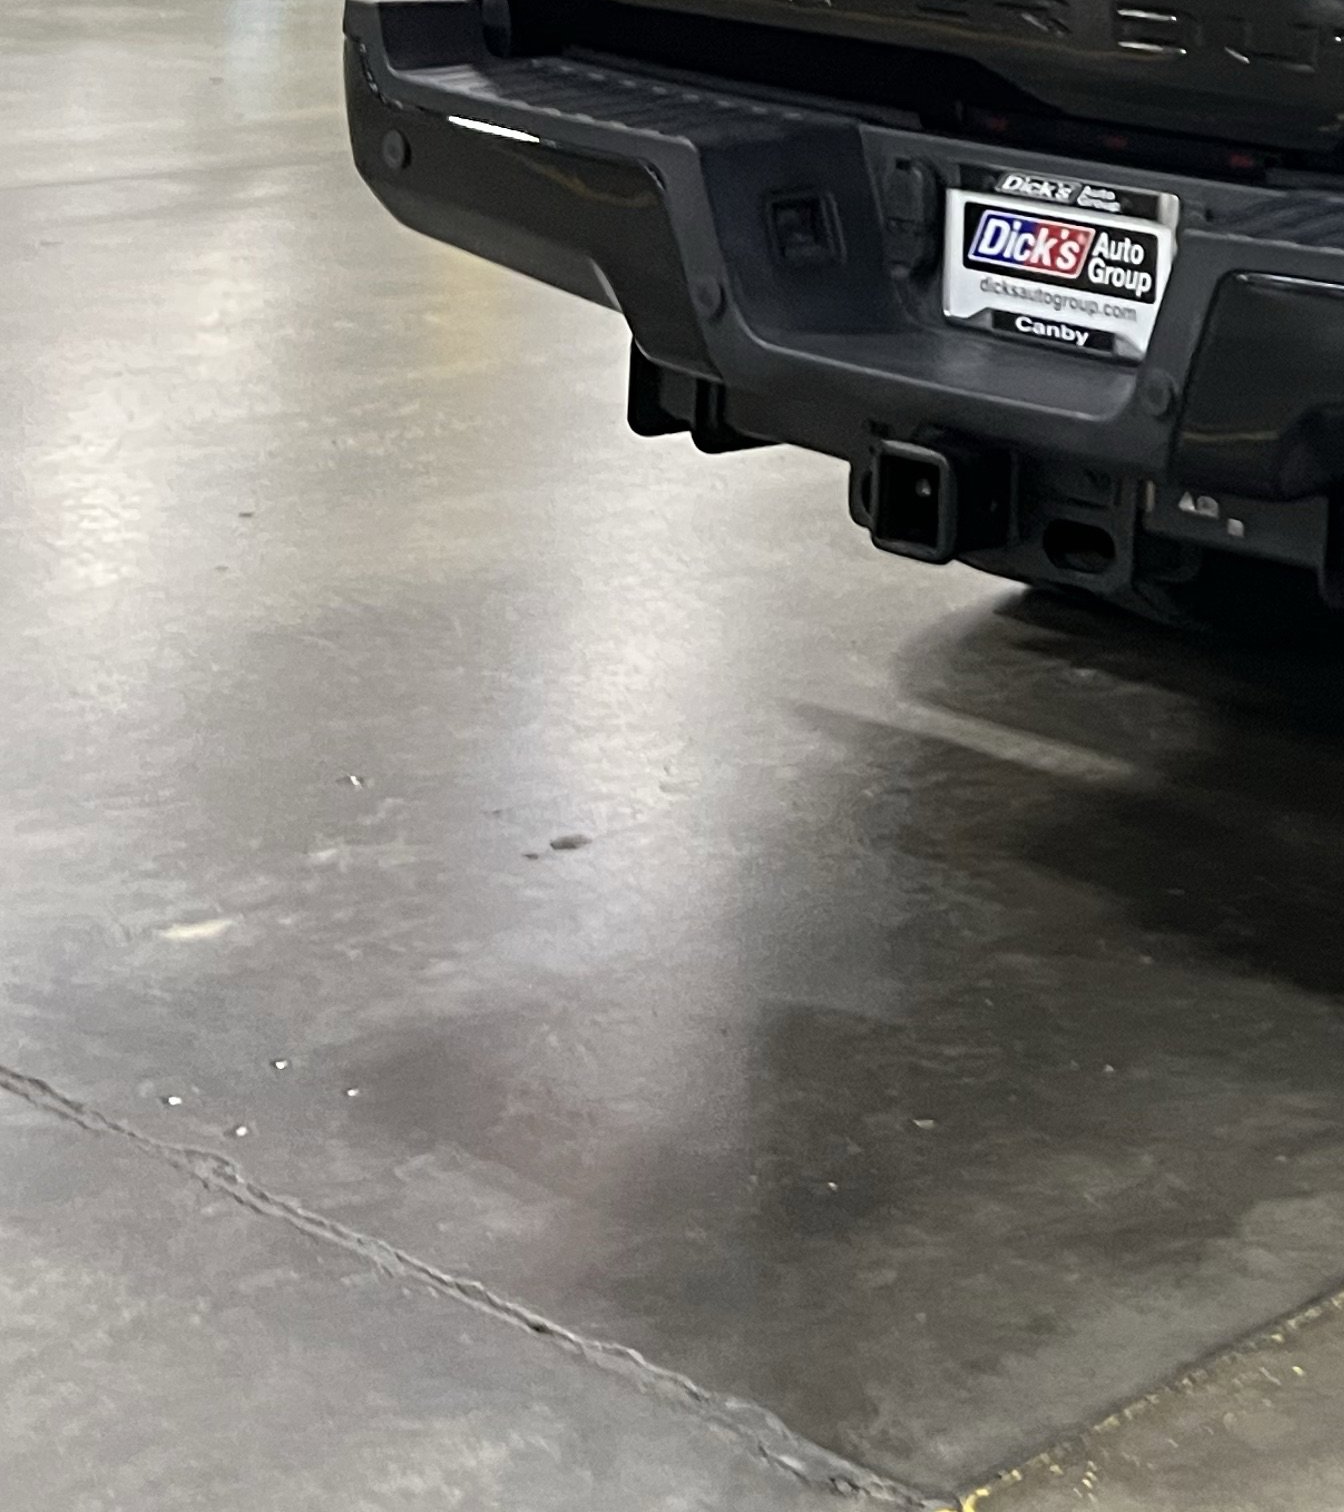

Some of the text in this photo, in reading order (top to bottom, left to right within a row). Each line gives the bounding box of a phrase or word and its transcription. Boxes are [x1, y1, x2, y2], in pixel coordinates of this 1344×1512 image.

[978, 219, 1081, 271] Dick's
[1092, 233, 1145, 265] Auto
[1087, 258, 1152, 298] Group
[979, 276, 1137, 322] dicksautogroup.com
[1014, 316, 1090, 347] Canby
